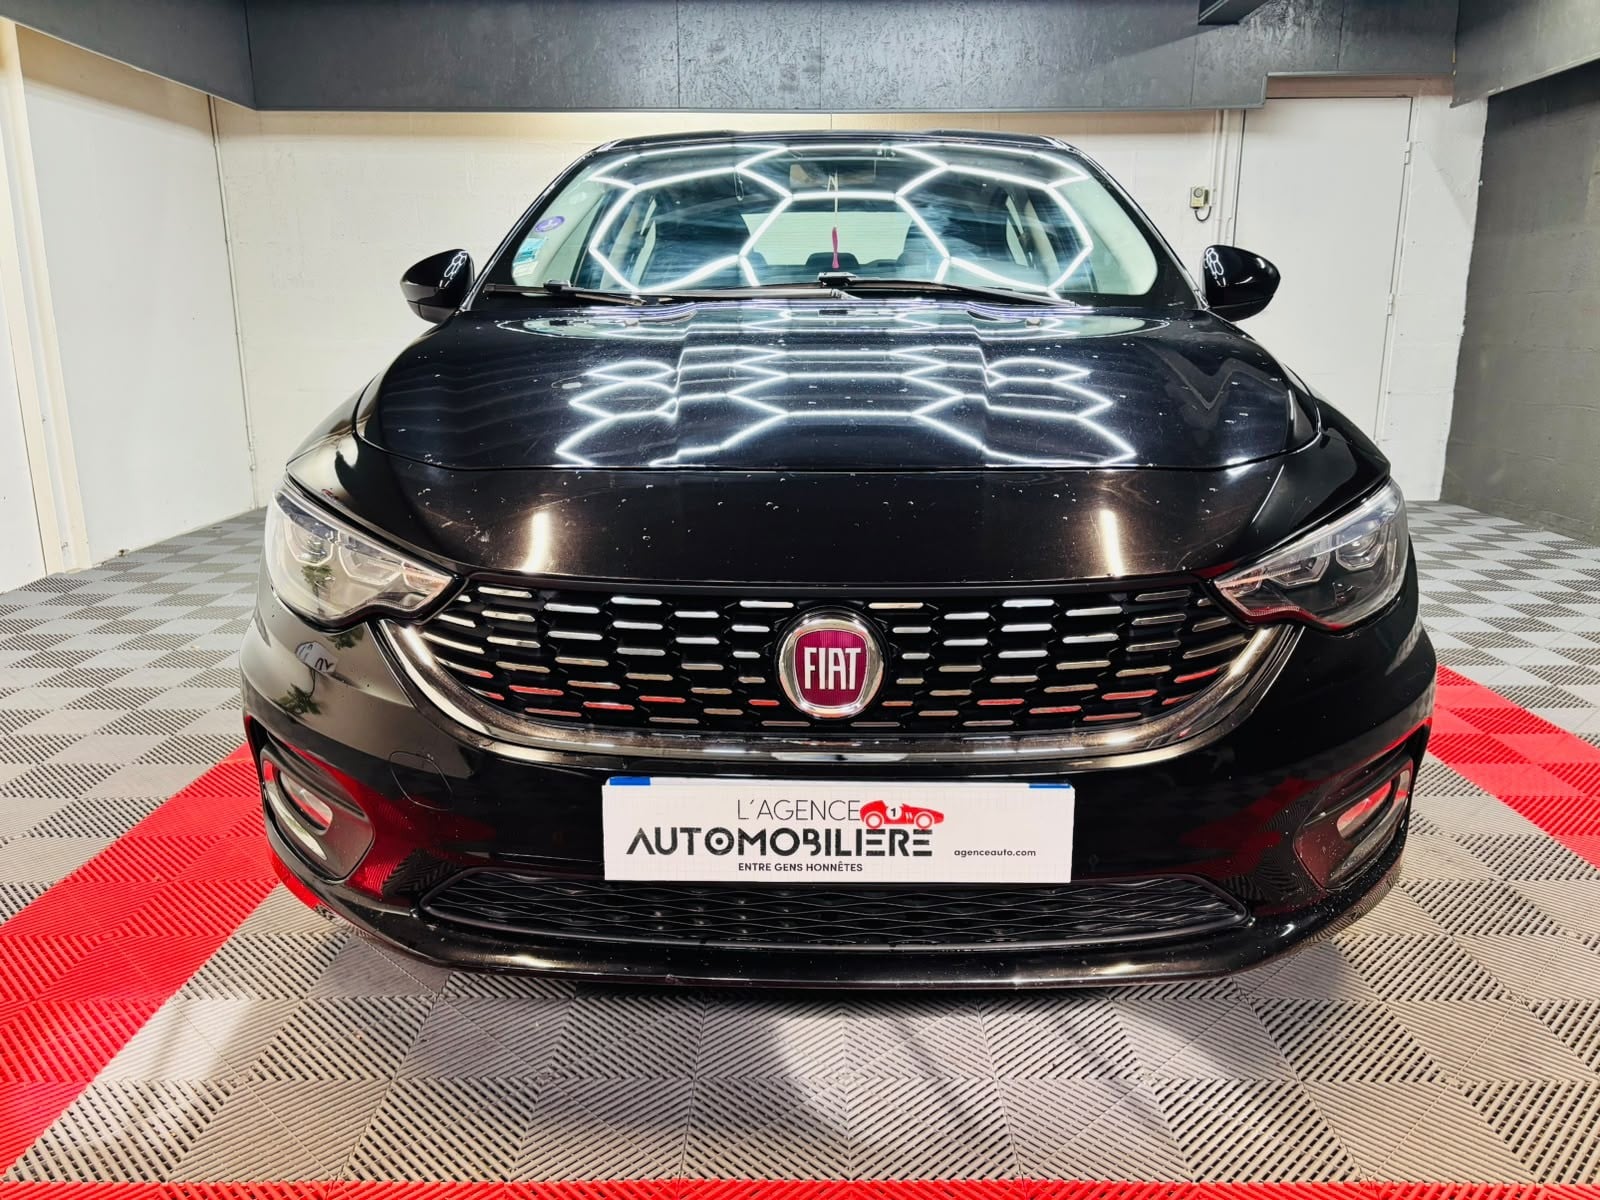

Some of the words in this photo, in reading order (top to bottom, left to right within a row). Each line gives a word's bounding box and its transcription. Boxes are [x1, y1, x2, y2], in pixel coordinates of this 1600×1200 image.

[804, 646, 861, 690] FIAT
[737, 799, 861, 821] L'AGENCE
[890, 807, 897, 818] 1
[953, 848, 1037, 858] agenceauto.com
[738, 862, 772, 872] ENTRE
[774, 862, 803, 872] GENS
[806, 860, 863, 872] HONNÊTES
